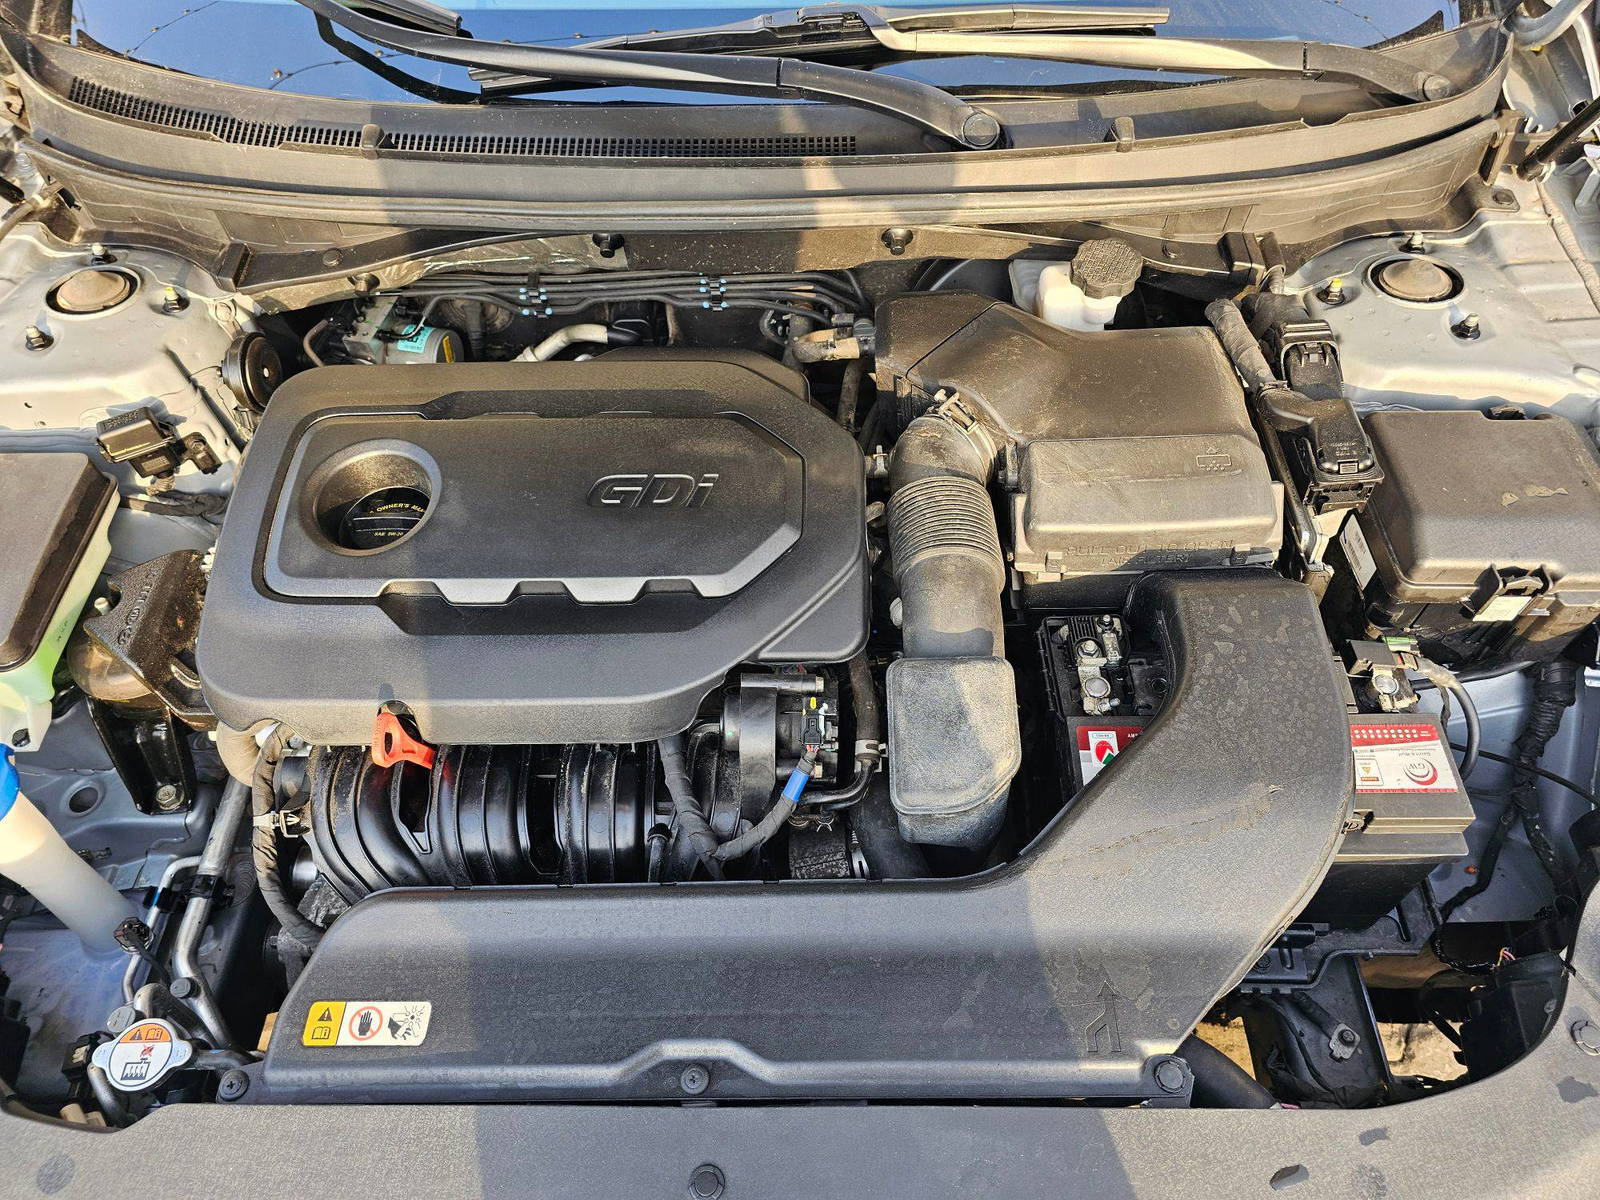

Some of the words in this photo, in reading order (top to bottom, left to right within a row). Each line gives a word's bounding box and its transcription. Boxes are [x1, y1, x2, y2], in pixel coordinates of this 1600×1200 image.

[586, 473, 719, 508] GDi
[376, 503, 410, 512] OWNER'S
[1065, 545, 1108, 557] PULL
[1114, 543, 1150, 556] OUT
[1156, 542, 1181, 553] TO
[1183, 539, 1234, 552] OPEN
